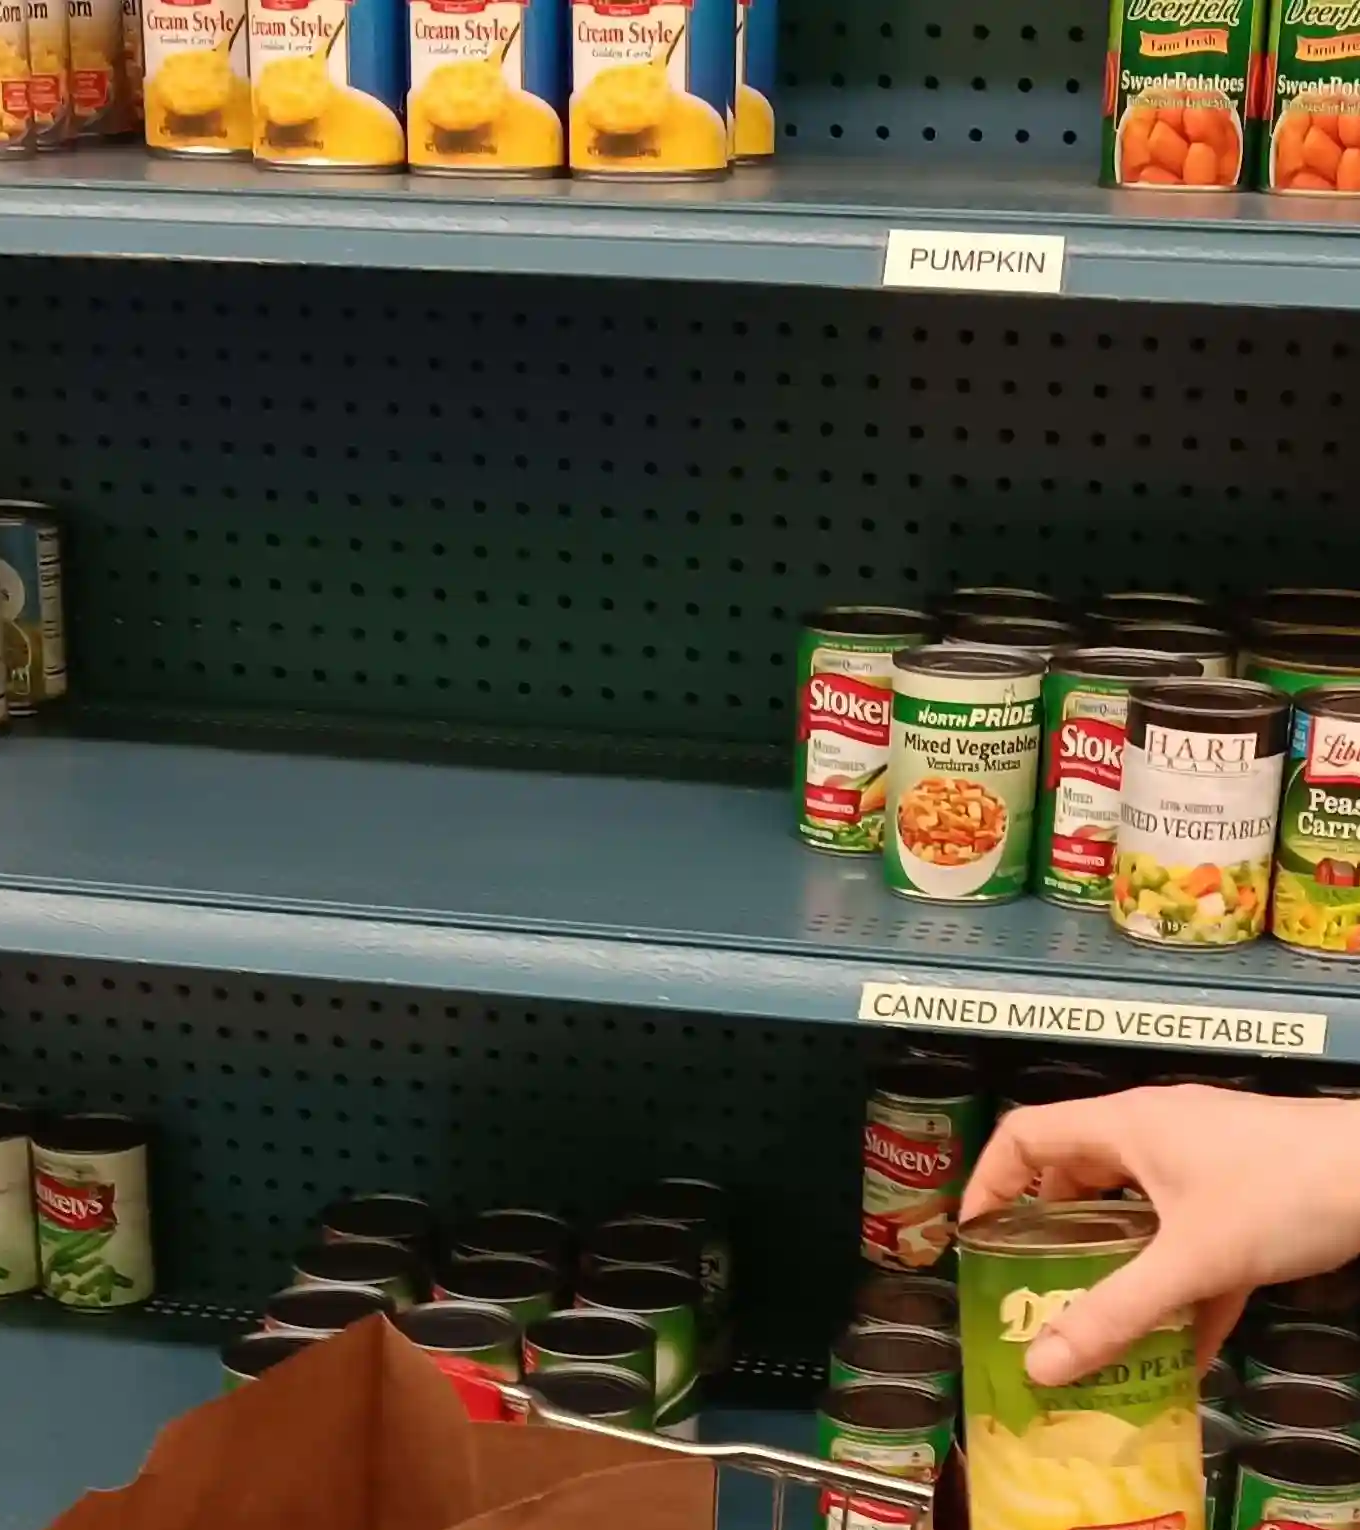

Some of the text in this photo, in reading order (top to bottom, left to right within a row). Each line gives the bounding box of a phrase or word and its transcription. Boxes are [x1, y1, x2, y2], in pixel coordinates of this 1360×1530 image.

[26, 2, 48, 19] orn
[68, 0, 93, 17] orn
[1126, 0, 1241, 27] Deerfield
[146, 9, 235, 38] Cream Style
[251, 14, 334, 44] Cream Style
[415, 18, 509, 48] Cream Style
[577, 20, 674, 51] Cream Style
[1184, 33, 1217, 49] Fresh
[909, 247, 1046, 274] PUMPKIN
[917, 703, 1035, 729] NORTH PRIDE
[904, 730, 1038, 760] Mixed Vegetables
[1148, 731, 1258, 762] HART
[926, 755, 1022, 773] Verduras Mixtas
[1161, 814, 1277, 842] VEGETABLES
[872, 992, 1306, 1047] CANNED MIXED VEGETABLES
[1140, 1347, 1197, 1383] PEAR
